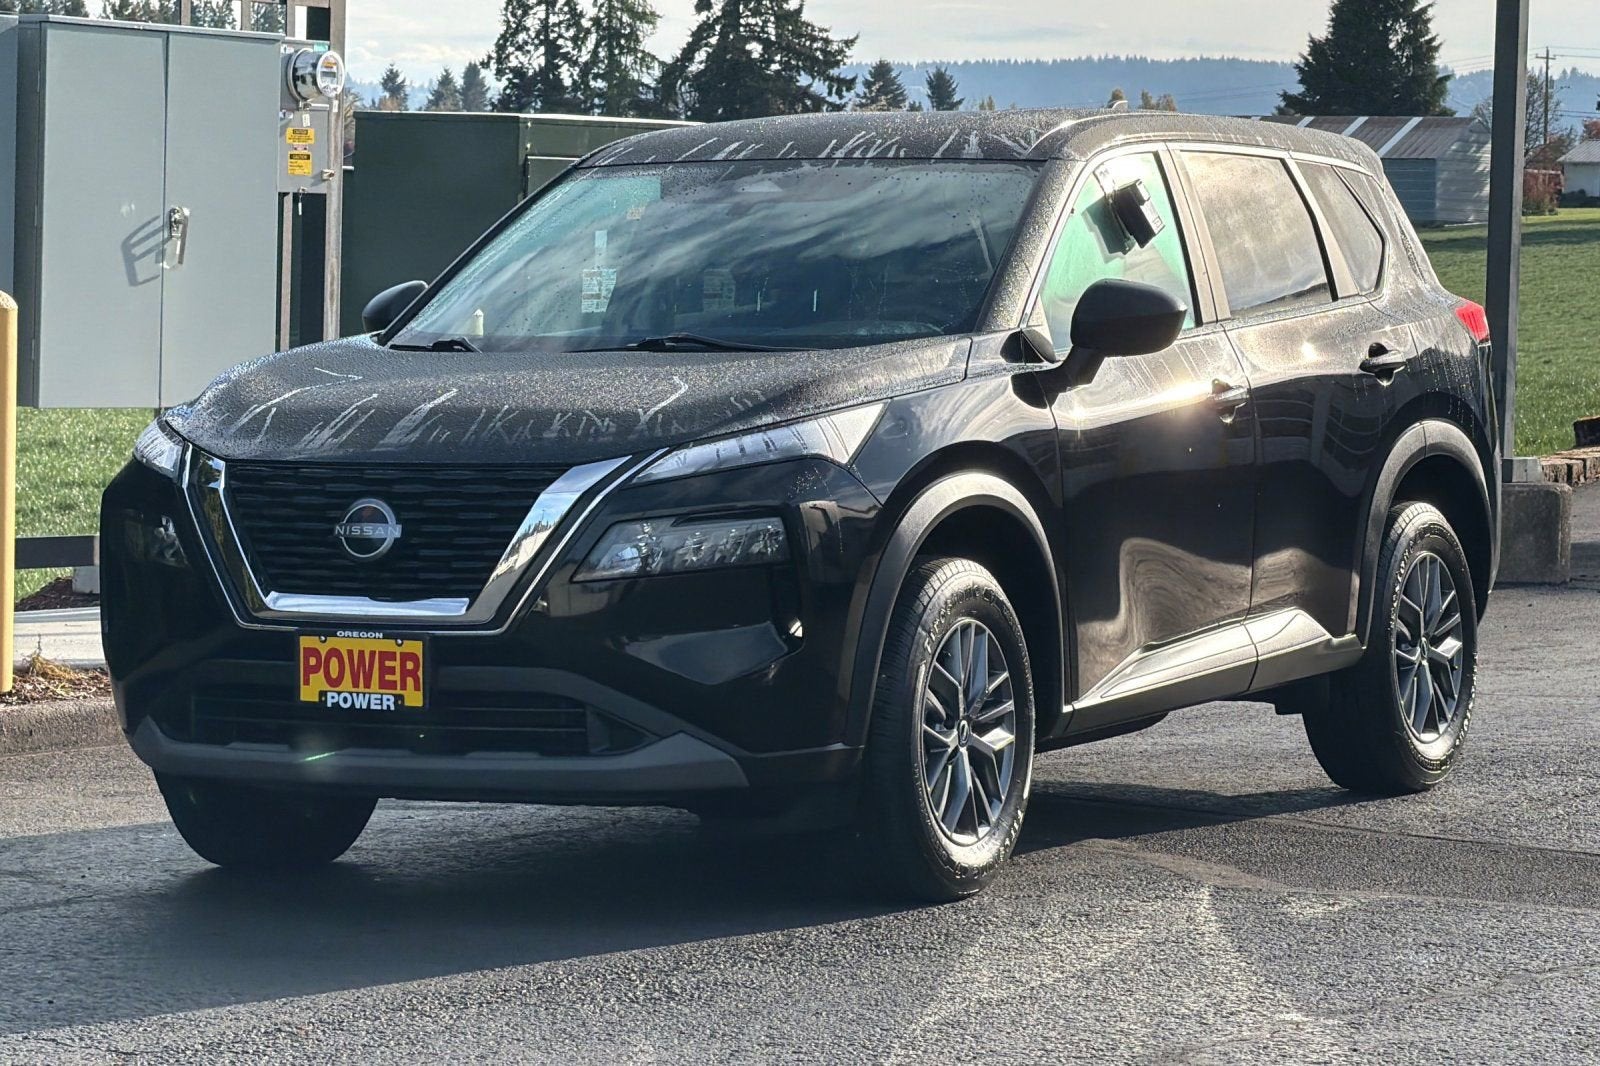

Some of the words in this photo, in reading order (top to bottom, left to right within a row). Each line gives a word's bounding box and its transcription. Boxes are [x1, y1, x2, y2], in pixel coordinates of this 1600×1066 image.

[335, 525, 400, 536] NISSAN
[336, 630, 383, 639] OREGON
[303, 647, 421, 691] POWER
[327, 692, 395, 710] POWER
